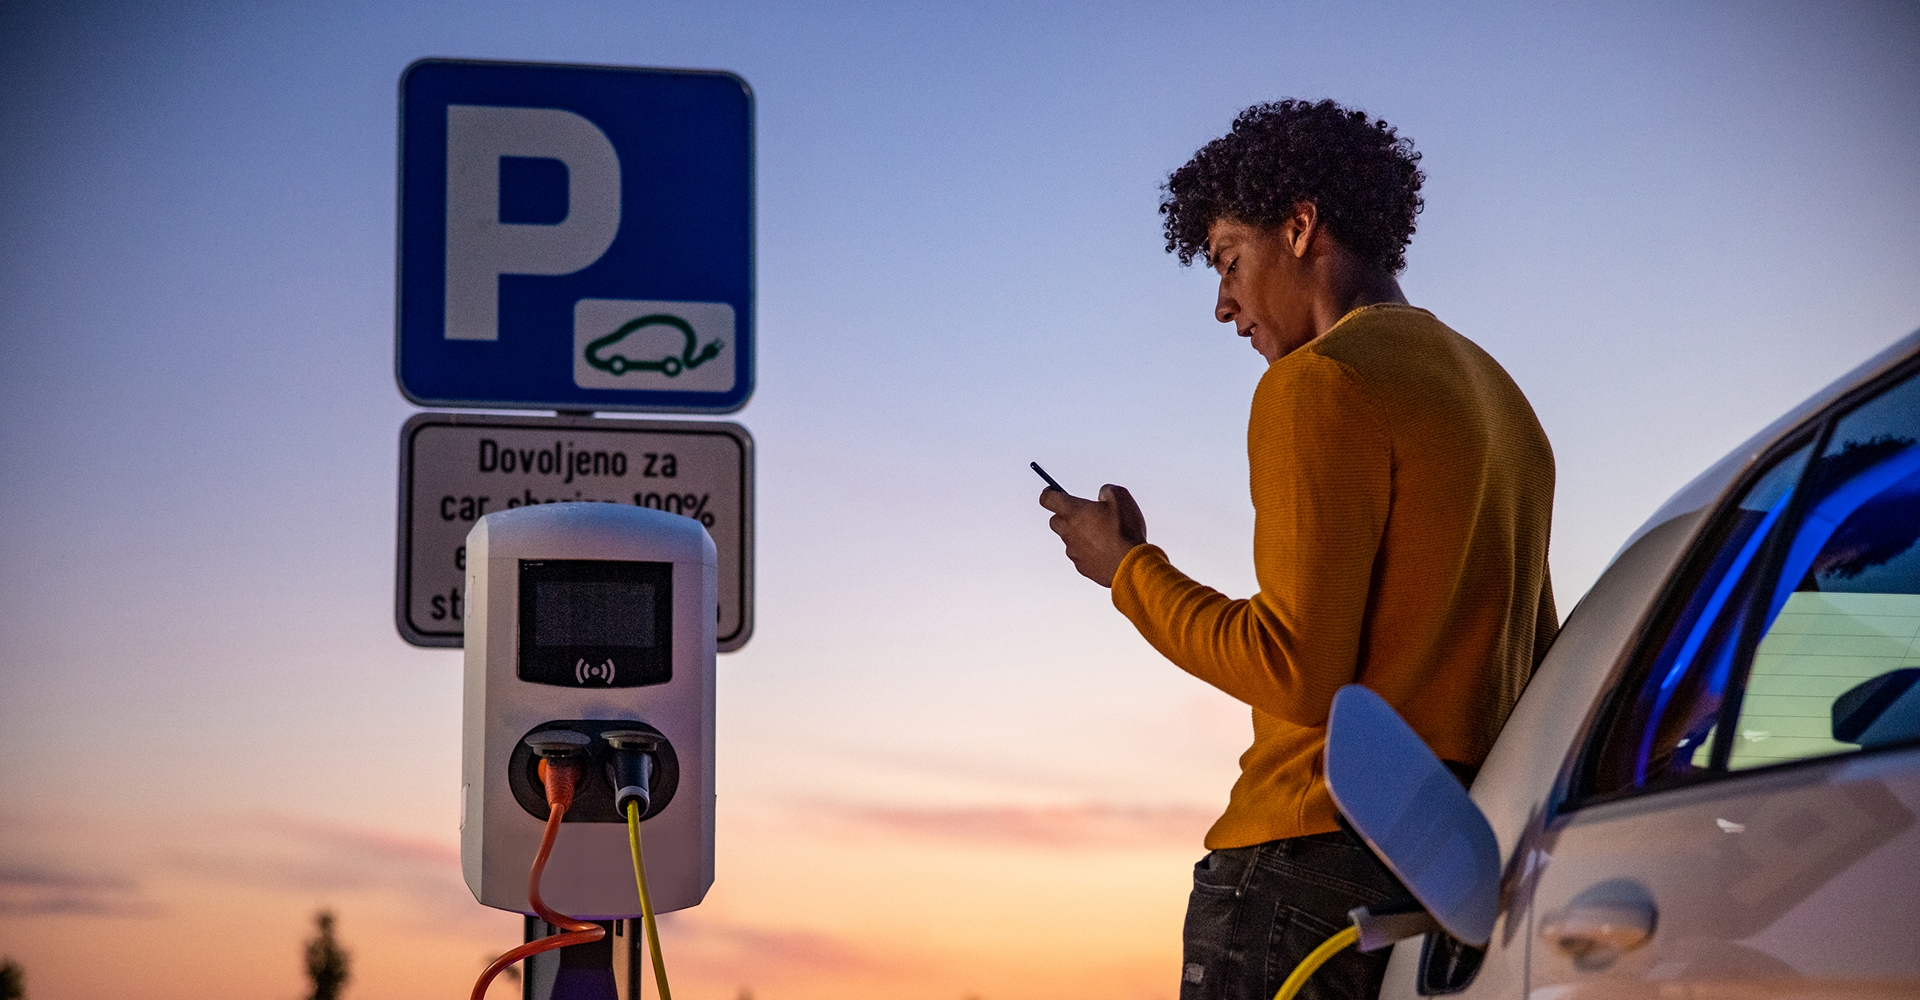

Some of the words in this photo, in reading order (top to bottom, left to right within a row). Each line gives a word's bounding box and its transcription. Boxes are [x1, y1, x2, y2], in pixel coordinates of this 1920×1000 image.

[444, 104, 621, 341] P
[479, 439, 628, 484] Dovoljeno
[643, 452, 677, 478] za
[440, 495, 490, 521] car
